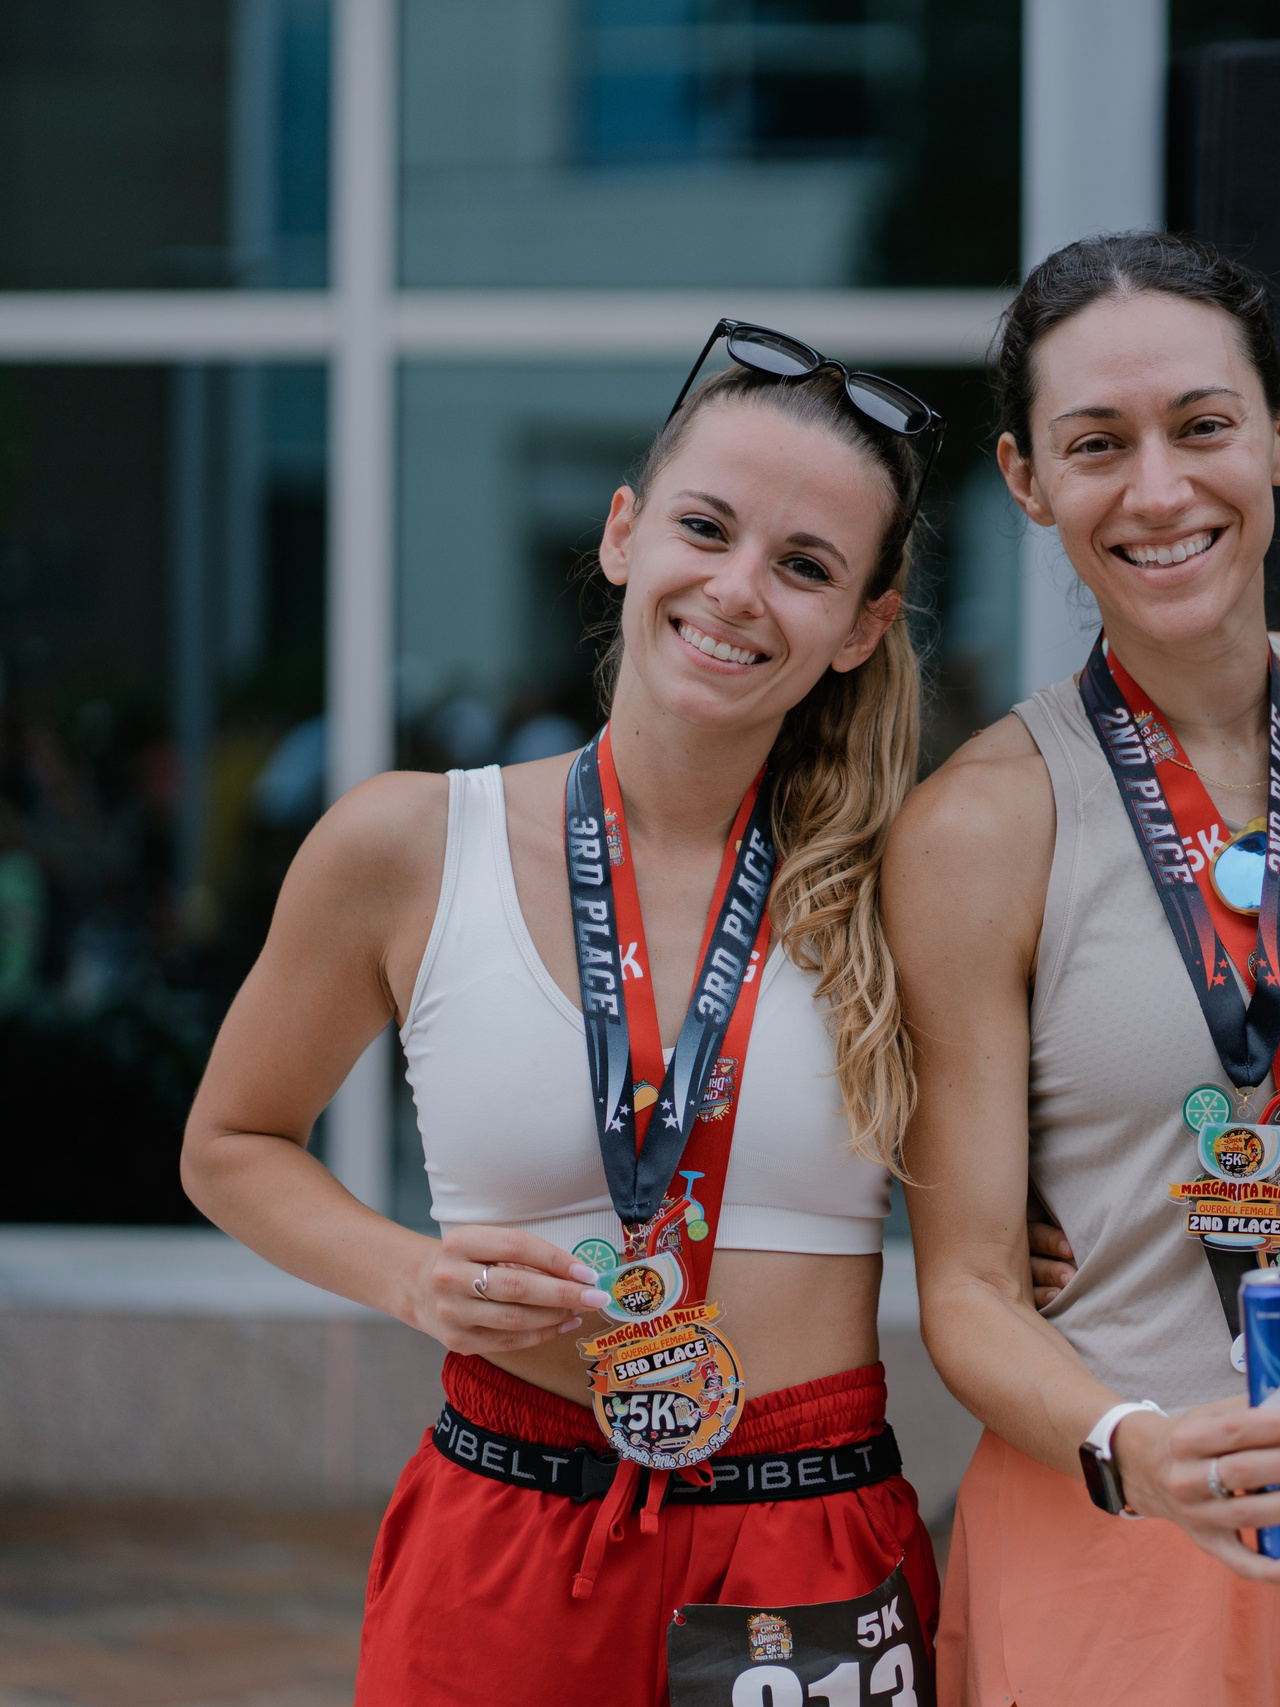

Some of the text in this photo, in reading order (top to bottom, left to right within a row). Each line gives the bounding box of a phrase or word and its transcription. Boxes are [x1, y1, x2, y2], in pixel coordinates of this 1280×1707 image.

[1095, 705, 1149, 767] 2ND
[1123, 777, 1197, 886] PLACE
[568, 815, 605, 887] 3RD
[695, 828, 775, 1027] 3RD PLACE
[574, 896, 622, 1025] PLACE
[1225, 1153, 1242, 1166] 5K
[1180, 1181, 1259, 1202] MARGARITA
[1199, 1204, 1274, 1216] OVERALL FEMALE
[1188, 1215, 1280, 1235] 2ND PLACE
[627, 1291, 645, 1306] 5K
[596, 1307, 707, 1349] MARGARITA MILE
[620, 1330, 695, 1361] OVERALL FEMALE
[615, 1340, 708, 1381] 3RD PLACE
[627, 1393, 676, 1431] 5K
[611, 1429, 651, 1466] Margarita
[652, 1453, 677, 1469] Mile
[677, 1454, 688, 1467] &
[687, 1445, 713, 1465] Taco
[760, 1624, 780, 1635] CINCO
[856, 1595, 905, 1649] 5K
[766, 1644, 777, 1655] 5K
